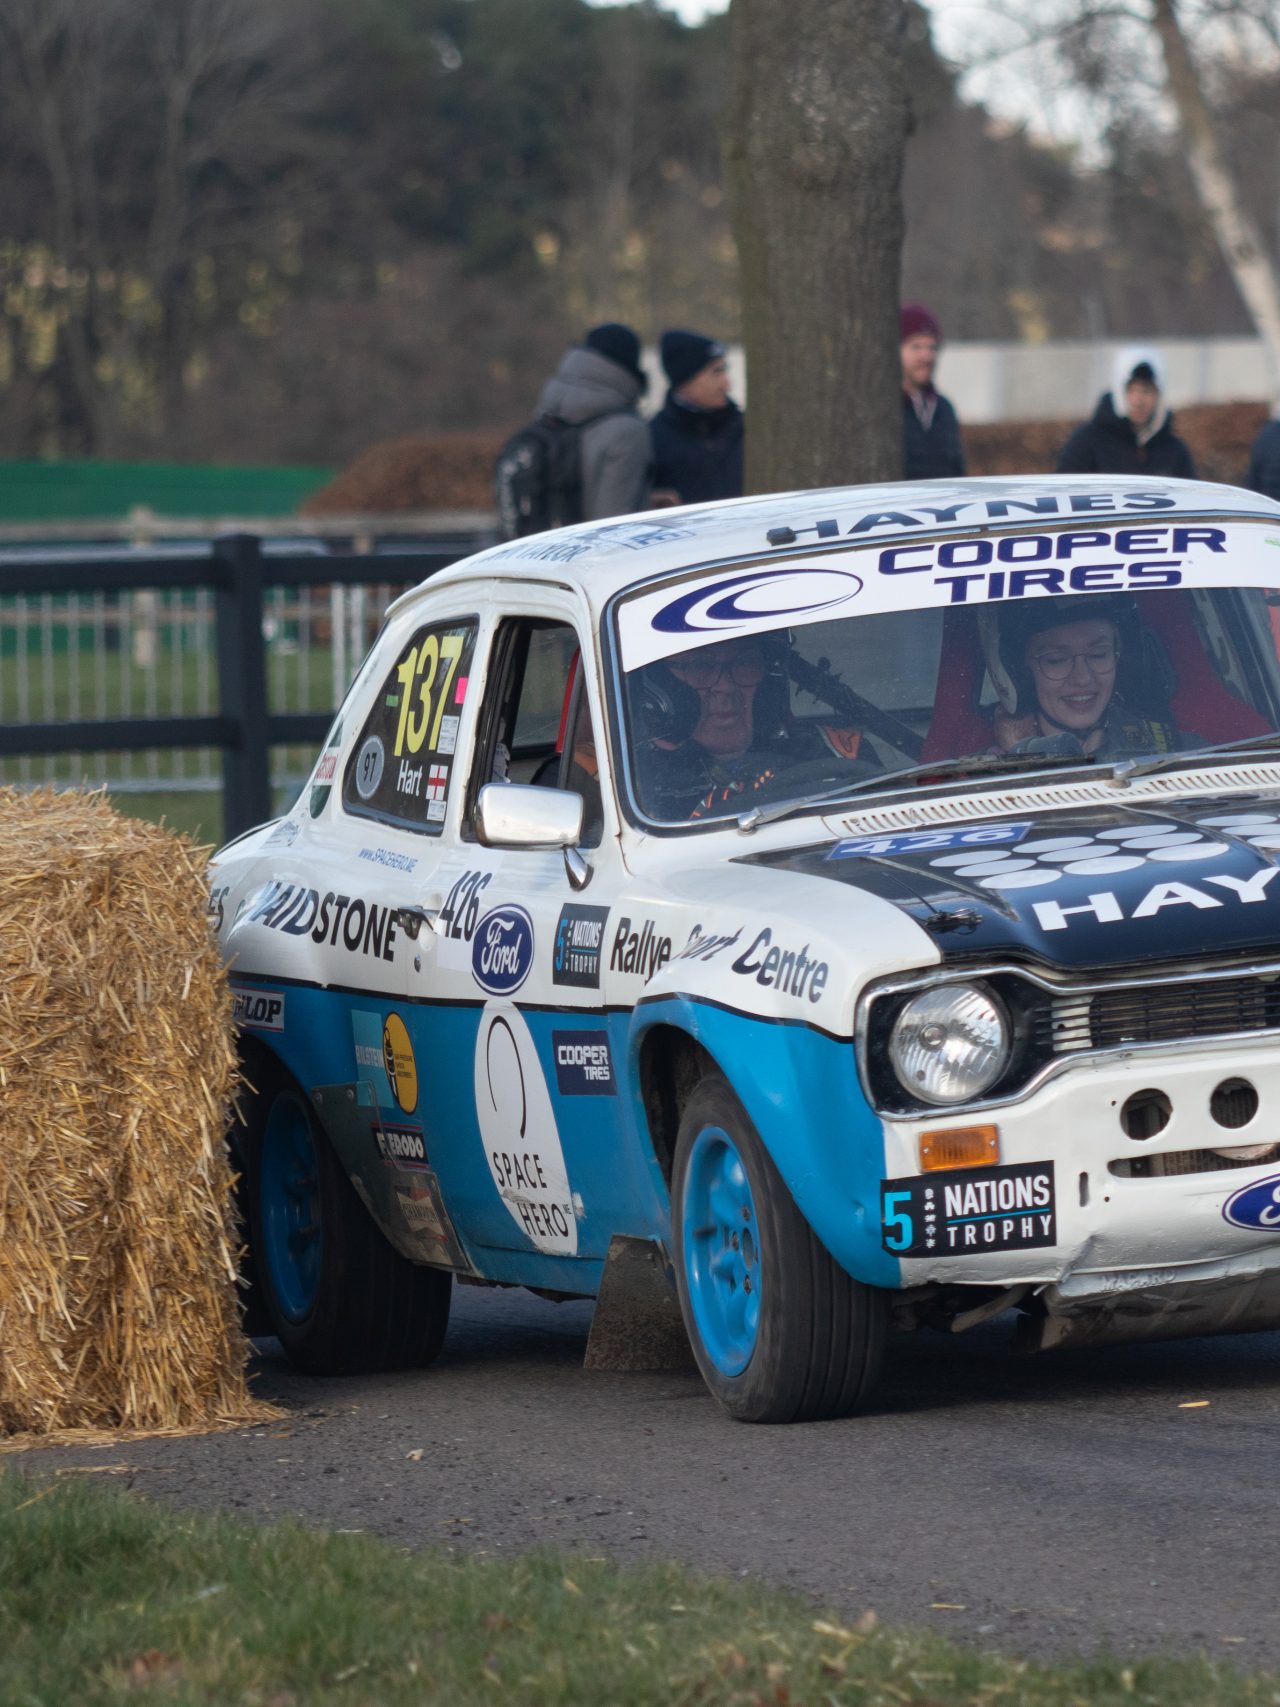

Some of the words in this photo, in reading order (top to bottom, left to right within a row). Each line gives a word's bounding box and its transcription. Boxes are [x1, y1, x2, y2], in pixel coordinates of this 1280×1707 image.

[768, 493, 1177, 546] HAYNES
[878, 527, 1228, 575] COOPER
[934, 560, 1182, 603] TIRES
[394, 634, 464, 757] 137
[363, 752, 378, 783] 97
[397, 759, 423, 798] Hart
[841, 828, 1015, 855] 426
[439, 871, 492, 942] 426
[481, 917, 523, 976] Ford
[555, 919, 569, 971] 5
[571, 920, 602, 949] NATIONS
[570, 955, 598, 975] TROPHY
[610, 917, 672, 985] Rallye
[731, 927, 829, 1004] Centre
[558, 1045, 609, 1065] COOPER
[583, 1066, 610, 1080] TIRES
[493, 1152, 547, 1190] SPACE
[517, 1203, 569, 1238] HERO
[884, 1190, 914, 1251] 5
[944, 1174, 1051, 1218] NATIONS
[946, 1214, 1052, 1247] TROPHY
